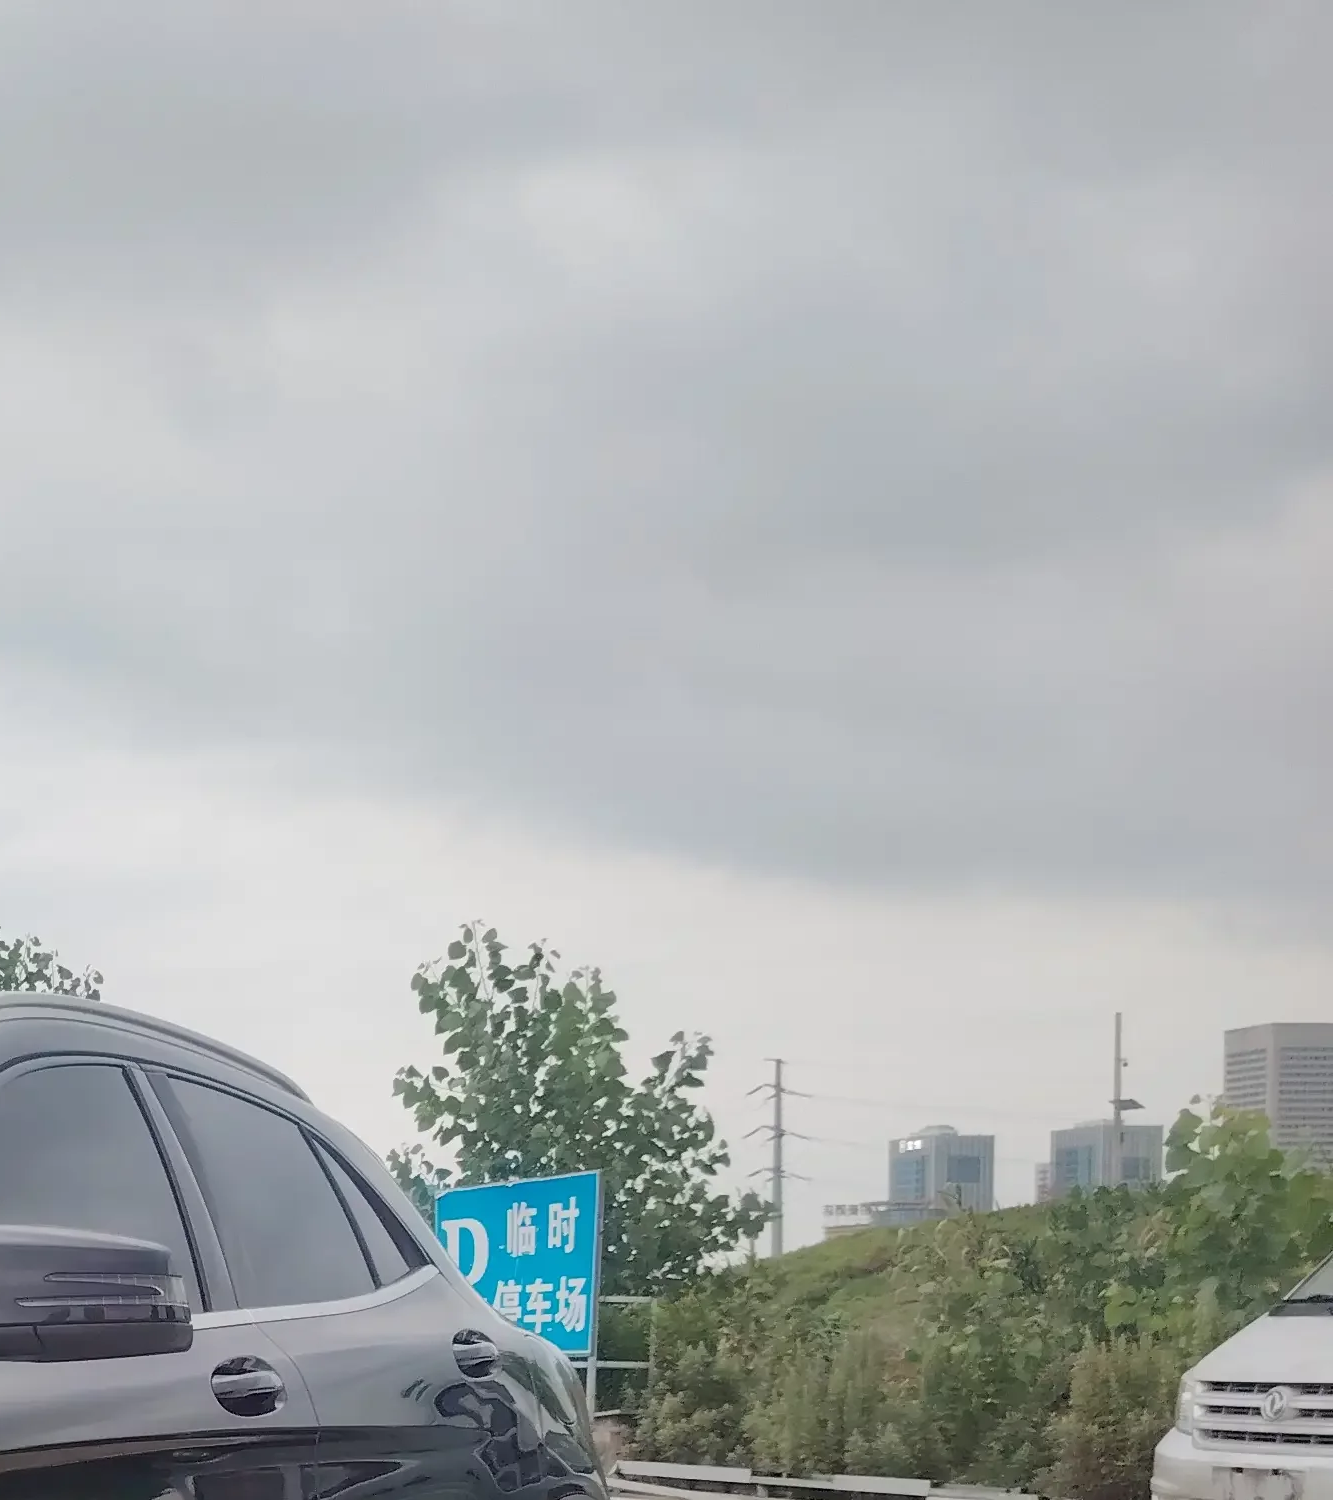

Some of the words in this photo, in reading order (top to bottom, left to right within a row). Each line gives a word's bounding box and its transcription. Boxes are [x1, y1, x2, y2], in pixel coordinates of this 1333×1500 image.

[506, 1196, 580, 1257] 临时
[492, 1275, 588, 1334] 停车场
